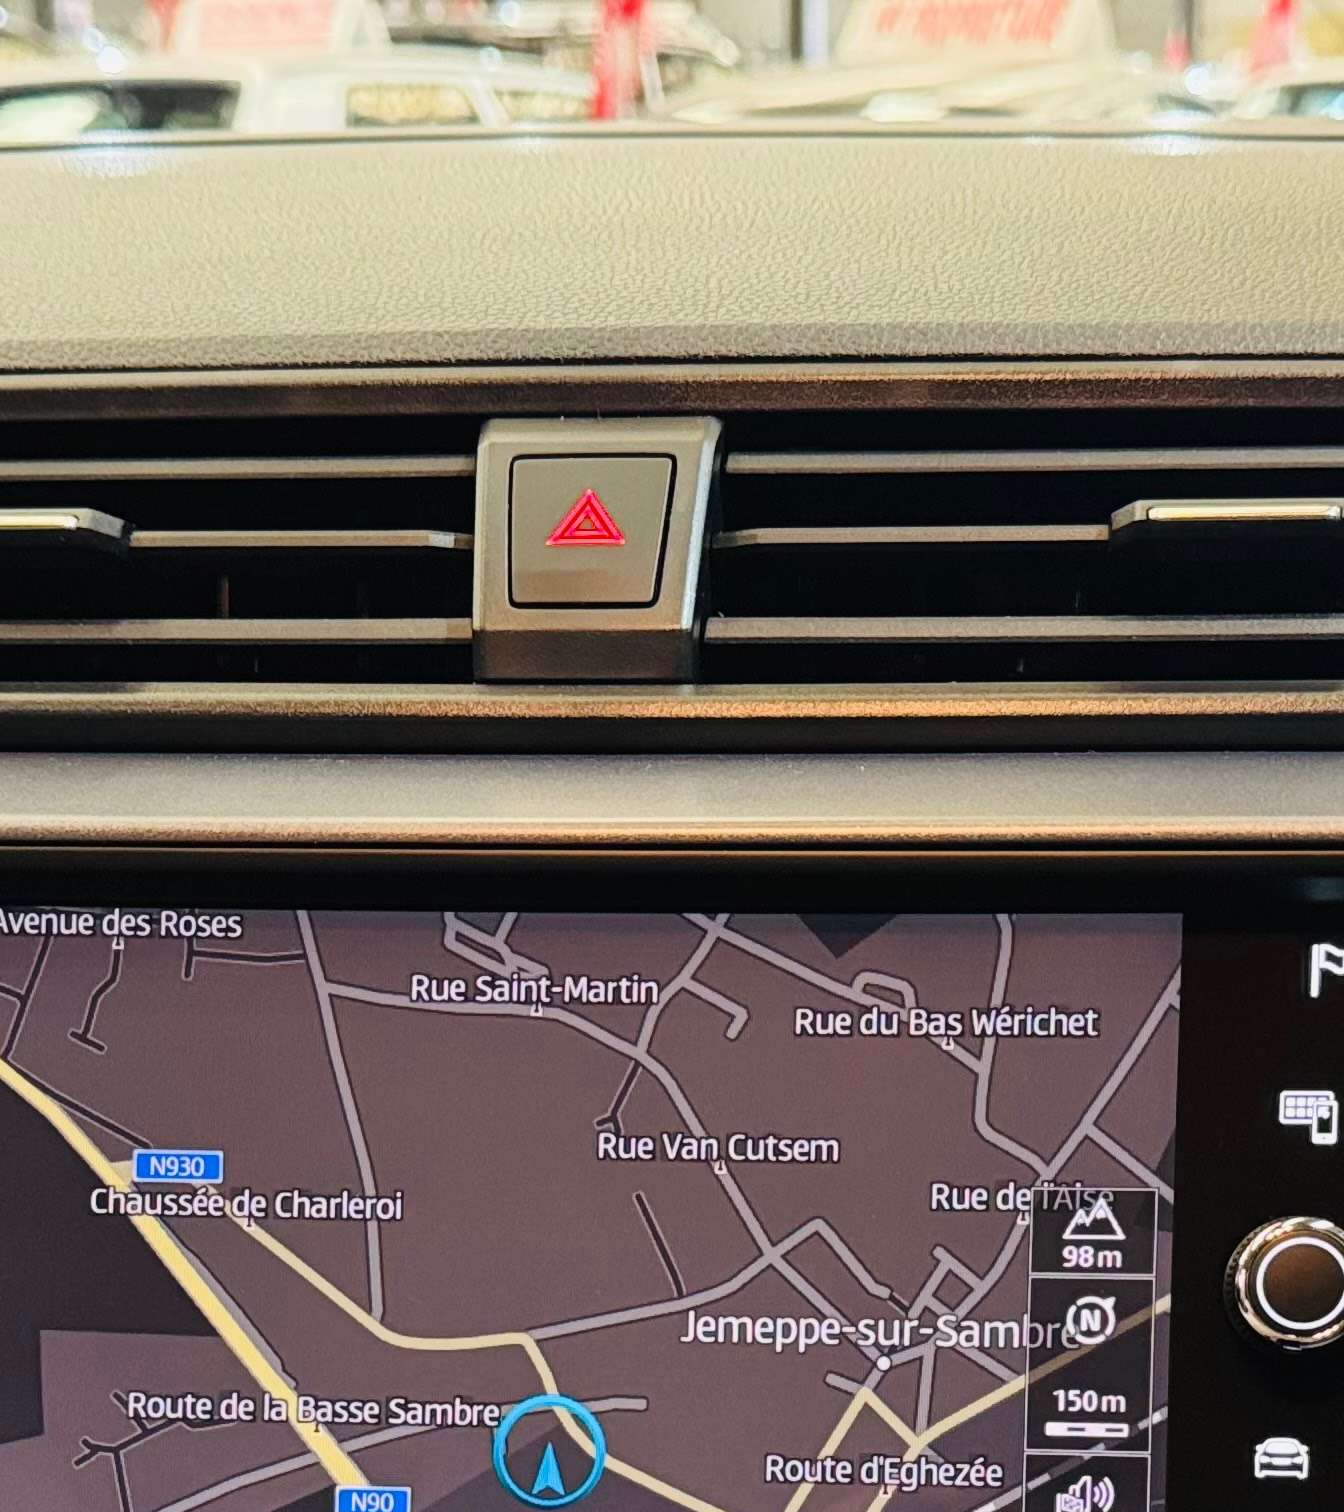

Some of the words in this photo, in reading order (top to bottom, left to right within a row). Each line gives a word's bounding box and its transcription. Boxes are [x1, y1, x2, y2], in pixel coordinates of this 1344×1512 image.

[102, 911, 152, 936] des
[160, 911, 243, 938] Roses
[410, 975, 465, 1002] Rue
[474, 975, 660, 1004] Saint-Martin
[794, 1008, 851, 1035] Rue
[859, 1008, 899, 1035] du
[908, 1009, 962, 1037] Bas
[971, 1008, 1099, 1037] Wérichet
[597, 1133, 654, 1160] Rue
[662, 1133, 718, 1161] Van
[728, 1133, 840, 1163] Cutsem
[149, 1155, 205, 1176] N930
[89, 1187, 224, 1216] Chaussée
[232, 1188, 267, 1217] de
[274, 1190, 403, 1219] Charleroi
[931, 1184, 988, 1211] Rue
[996, 1182, 1031, 1211] de
[128, 1392, 213, 1420] Route
[219, 1392, 255, 1421] de
[263, 1393, 288, 1422] la
[297, 1394, 379, 1423] Basse
[388, 1396, 500, 1427] Sambre
[765, 1455, 853, 1483] Route
[860, 1456, 1004, 1489] d'Eghezée
